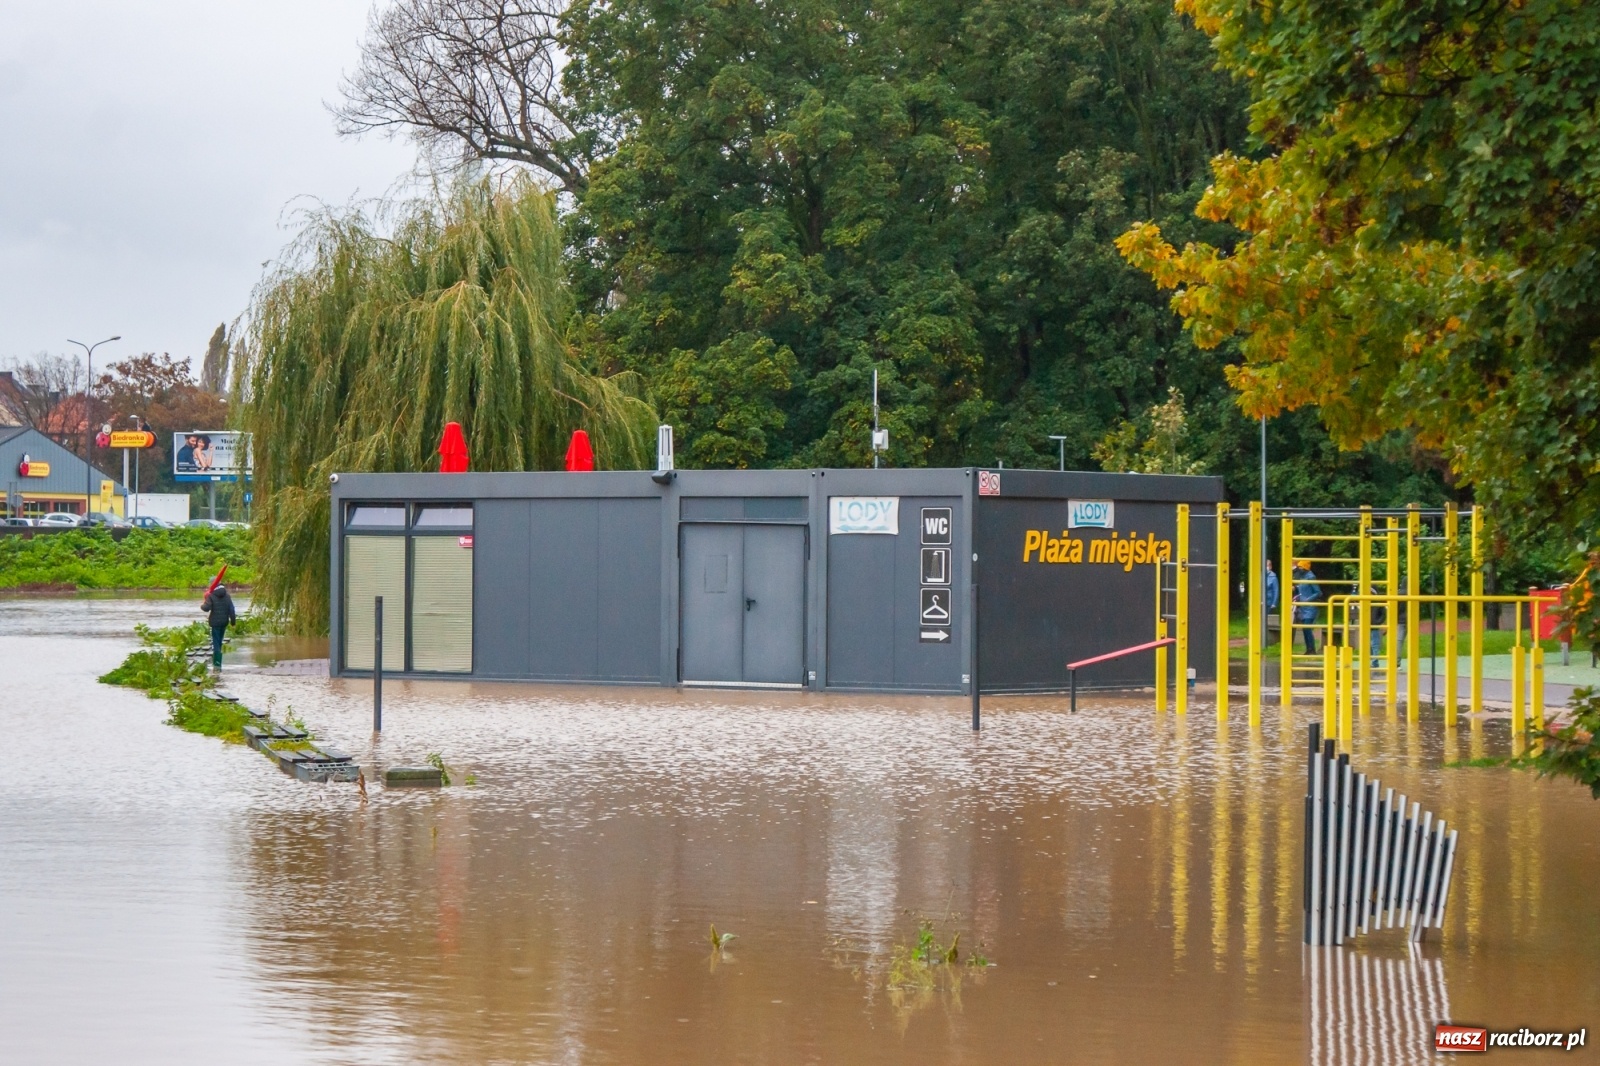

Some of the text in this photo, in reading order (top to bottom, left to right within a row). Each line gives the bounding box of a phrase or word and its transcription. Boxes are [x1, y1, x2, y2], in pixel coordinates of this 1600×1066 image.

[838, 501, 893, 522] LODY
[1079, 503, 1109, 520] LODY
[925, 517, 948, 535] WC
[1023, 529, 1172, 572] Plaża miejska
